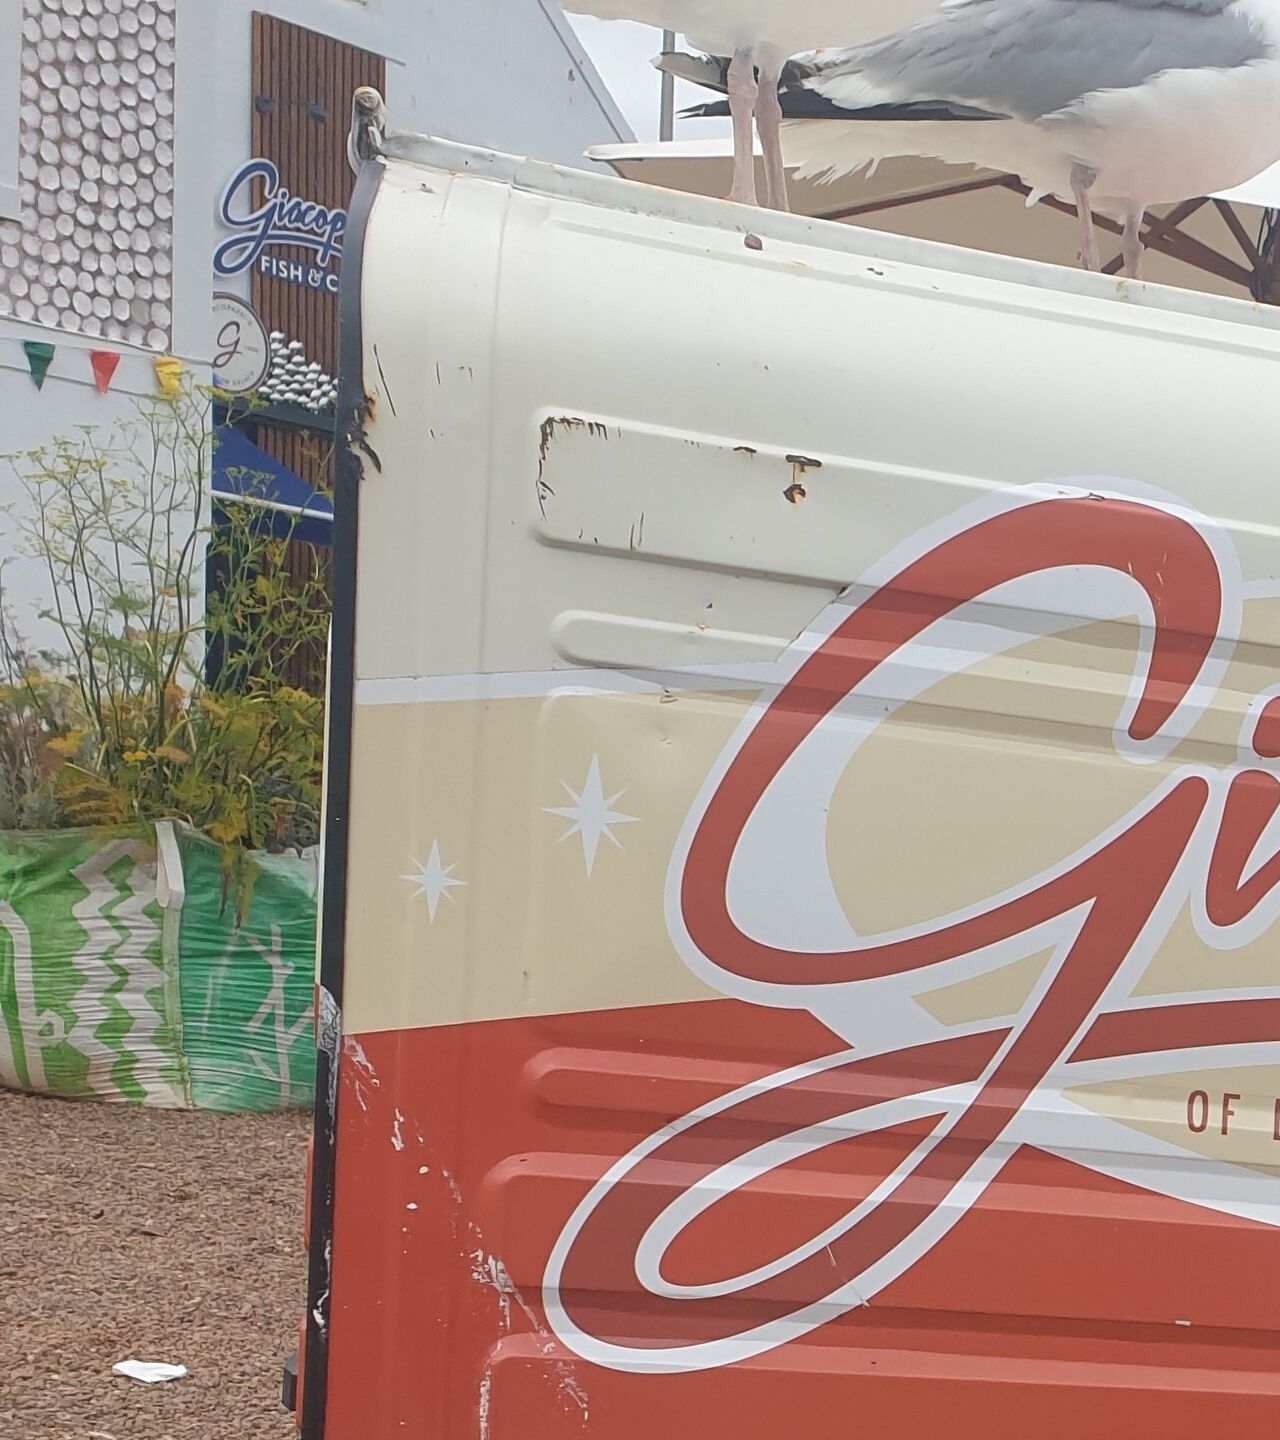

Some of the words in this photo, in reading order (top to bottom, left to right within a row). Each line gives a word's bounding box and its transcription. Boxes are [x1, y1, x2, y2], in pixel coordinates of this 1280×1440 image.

[261, 255, 302, 282] FISH
[308, 269, 323, 286] &
[1187, 1090, 1241, 1136] OF
